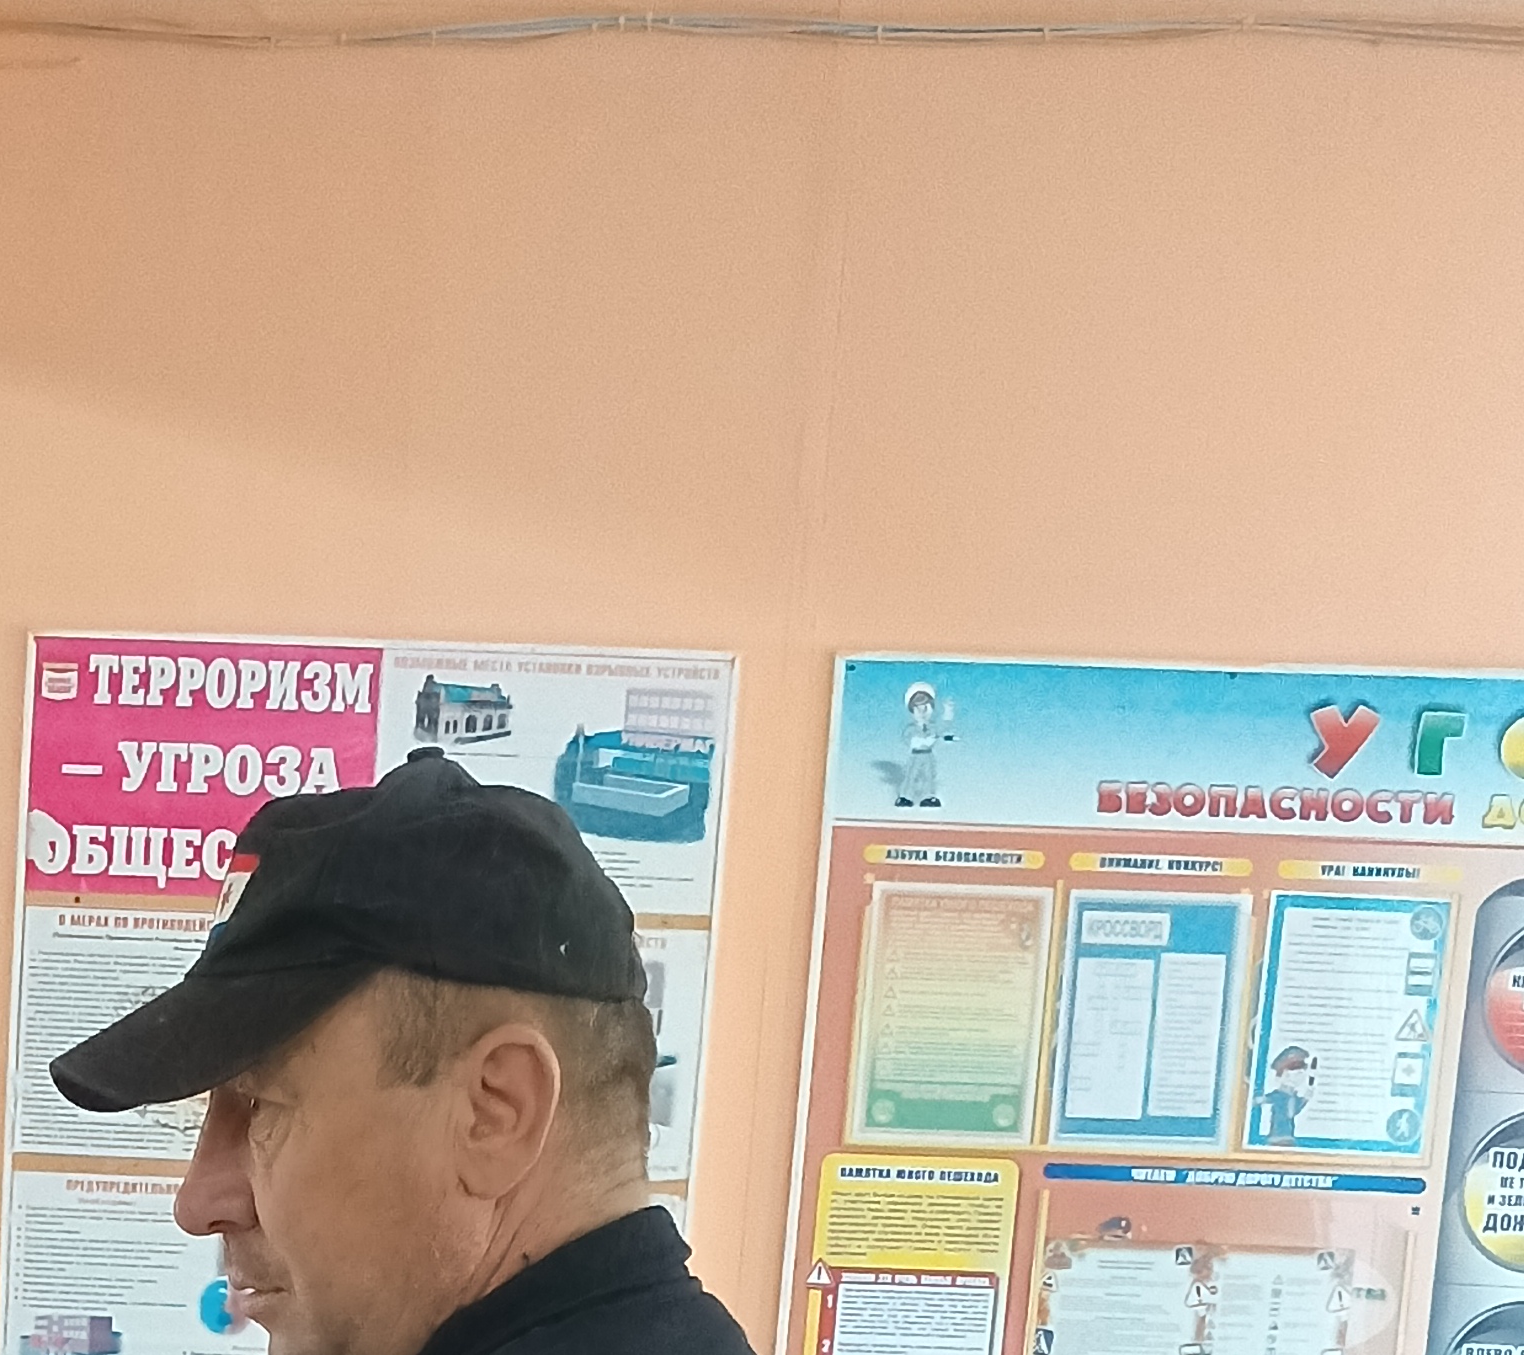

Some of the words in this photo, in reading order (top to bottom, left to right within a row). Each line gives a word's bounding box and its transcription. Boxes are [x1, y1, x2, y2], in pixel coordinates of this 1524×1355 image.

[88, 653, 374, 714] ТЕРРОРИЗМ
[117, 741, 341, 798] УГРОЗА
[1096, 780, 1456, 826] БЕЗОПАСНОСТИ
[28, 813, 238, 890] ОБЩЕС
